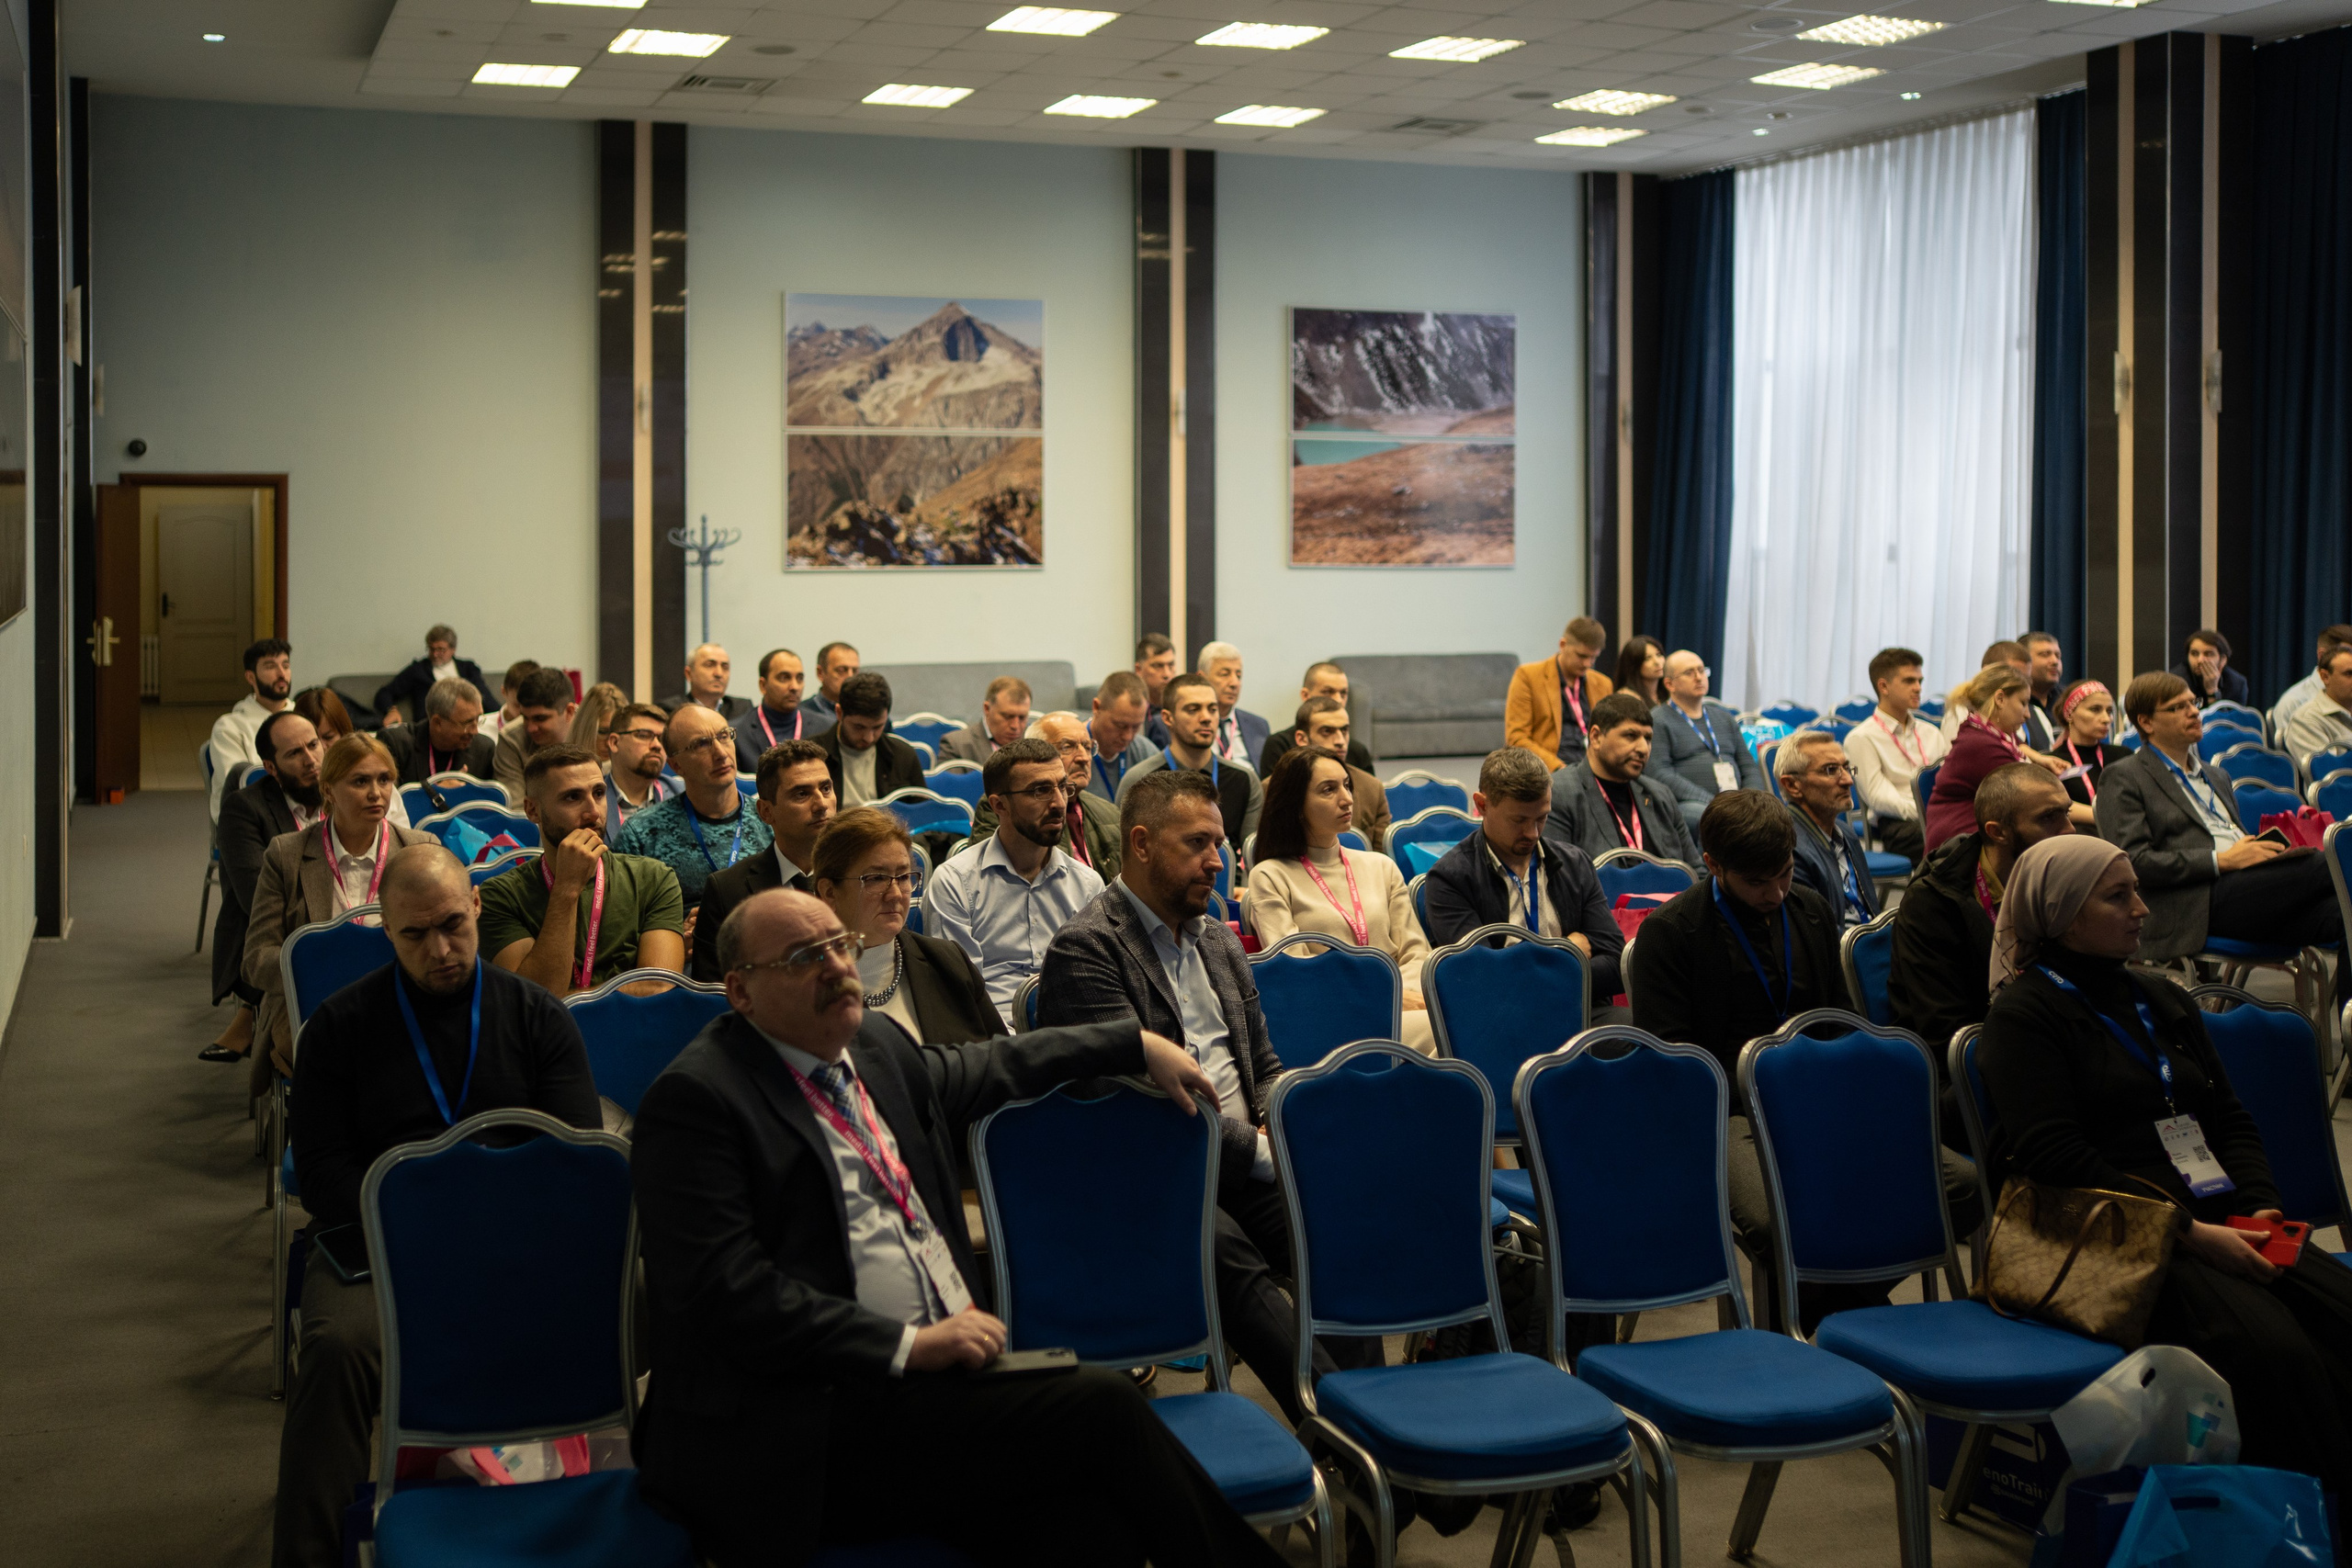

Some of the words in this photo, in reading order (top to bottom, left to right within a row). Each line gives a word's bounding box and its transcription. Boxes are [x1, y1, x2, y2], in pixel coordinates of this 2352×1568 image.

[797, 1079, 813, 1097] feel
[810, 1092, 835, 1121] better.
[845, 1130, 864, 1152] medi.
[866, 1155, 880, 1172] feel
